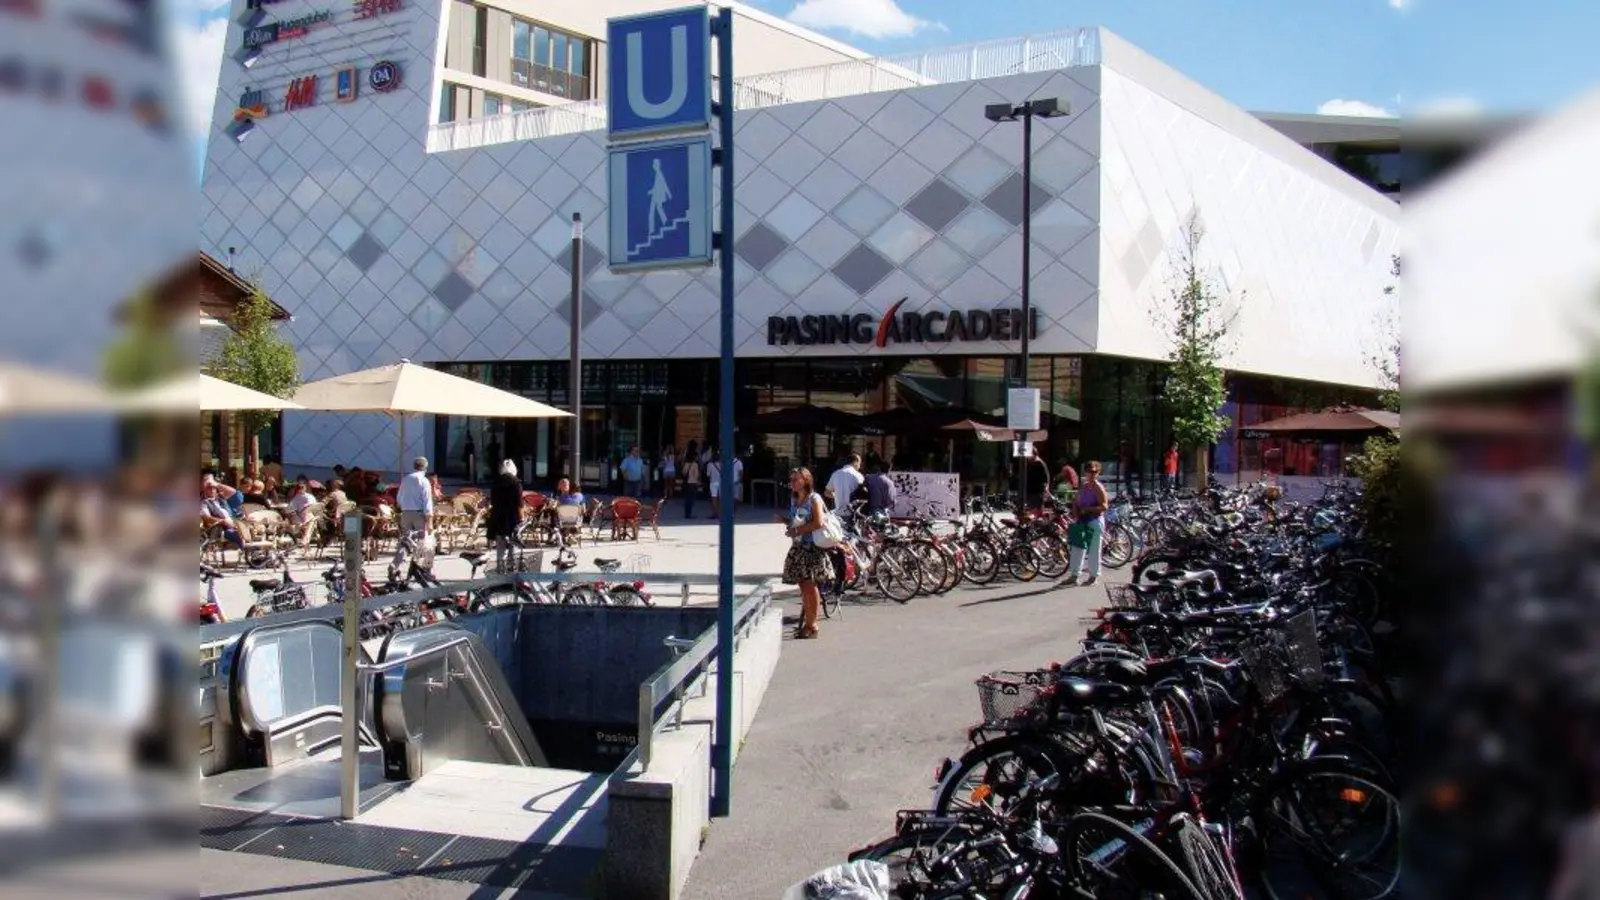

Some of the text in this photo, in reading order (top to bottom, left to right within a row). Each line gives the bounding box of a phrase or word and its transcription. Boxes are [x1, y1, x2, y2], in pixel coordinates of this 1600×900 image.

[626, 25, 688, 119] U
[767, 297, 1038, 348] PASING ARCADEN
[596, 731, 637, 746] Pasing
